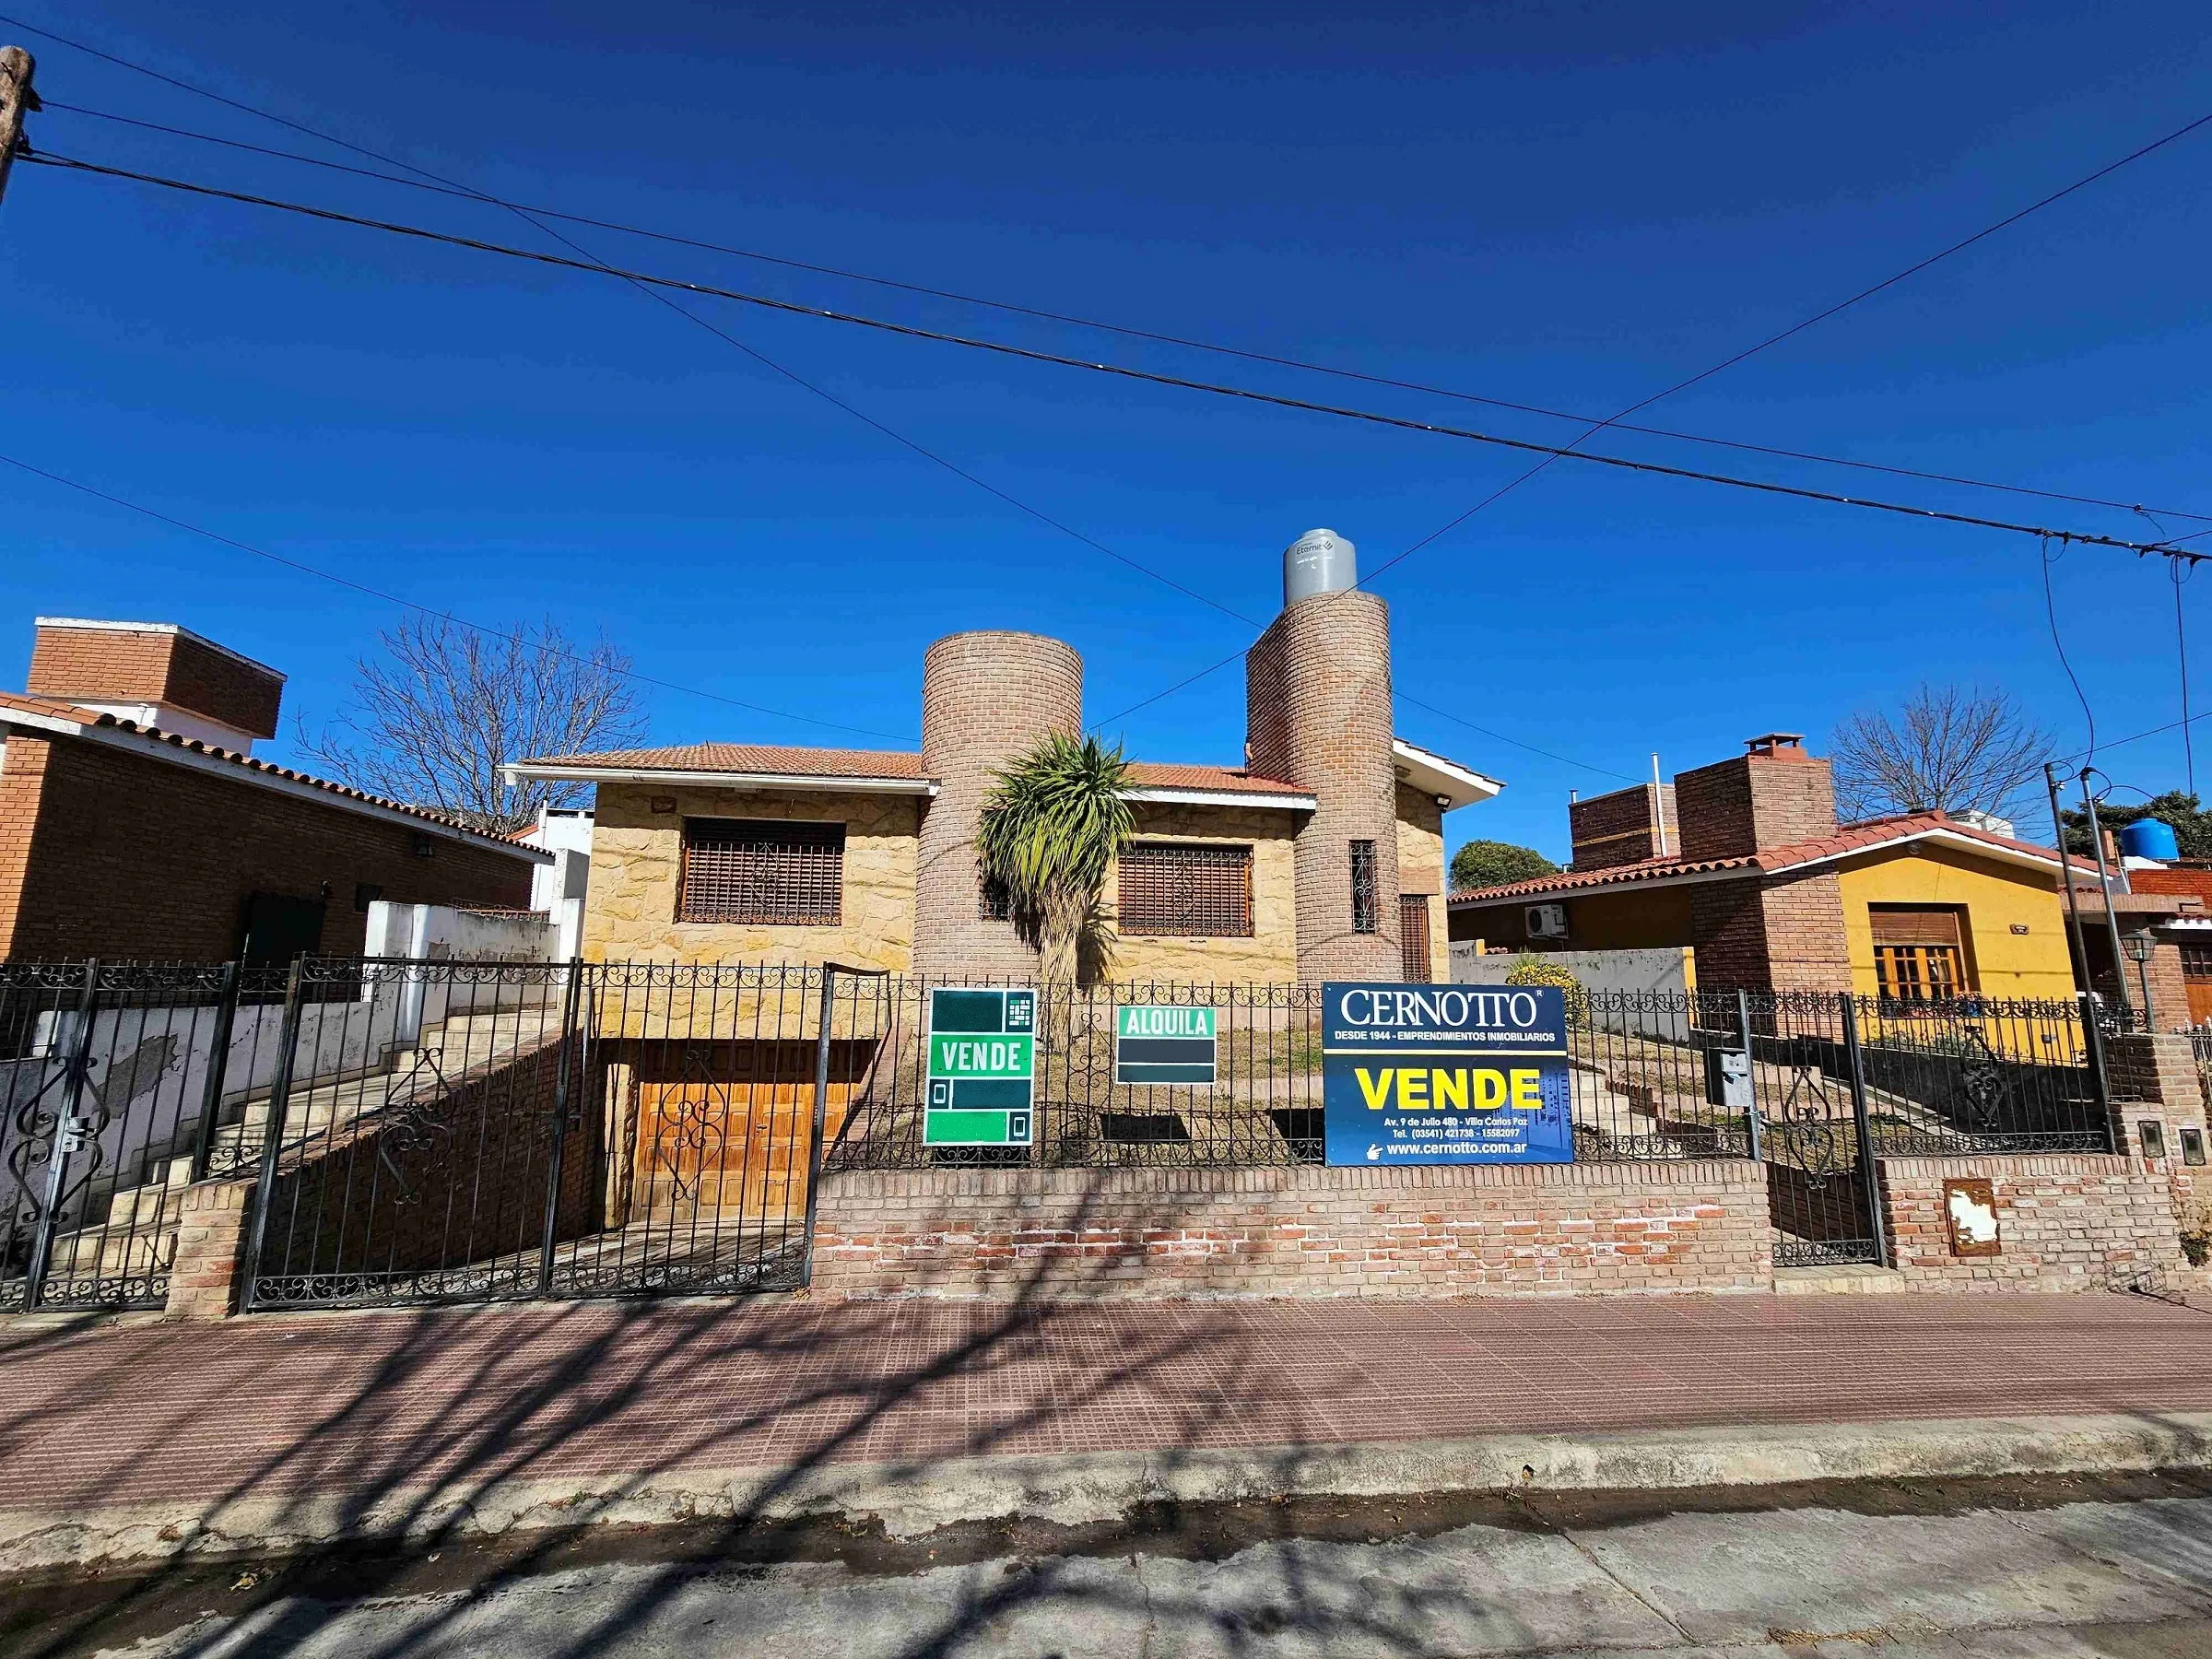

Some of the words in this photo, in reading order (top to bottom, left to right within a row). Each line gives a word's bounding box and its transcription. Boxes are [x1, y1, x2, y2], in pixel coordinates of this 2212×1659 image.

[1340, 989, 1537, 1028] CERNOTTO
[1125, 1009, 1208, 1035] ALQUILA
[1334, 1030, 1368, 1041] DESDE
[1369, 1030, 1391, 1041] 1944
[1397, 1031, 1486, 1041] EMPRENDIMIENTOS
[1487, 1032, 1556, 1042] INMOBILIARIOS
[941, 1042, 1021, 1071] VENDE
[1354, 1068, 1543, 1110] VENDE
[1383, 1117, 1399, 1127] Av.
[1400, 1117, 1406, 1126] 9
[1406, 1117, 1420, 1126] de
[1420, 1117, 1441, 1126] Julio
[1465, 1117, 1484, 1126] Villa
[1484, 1117, 1512, 1126] Carlos
[1512, 1117, 1529, 1126] Paz
[1393, 1129, 1408, 1138] Tel.
[1411, 1129, 1443, 1140] (03541)
[1444, 1128, 1475, 1138] 421738
[1481, 1128, 1520, 1138] 15582097
[1386, 1141, 1527, 1155] www.cernotto.com.ar
